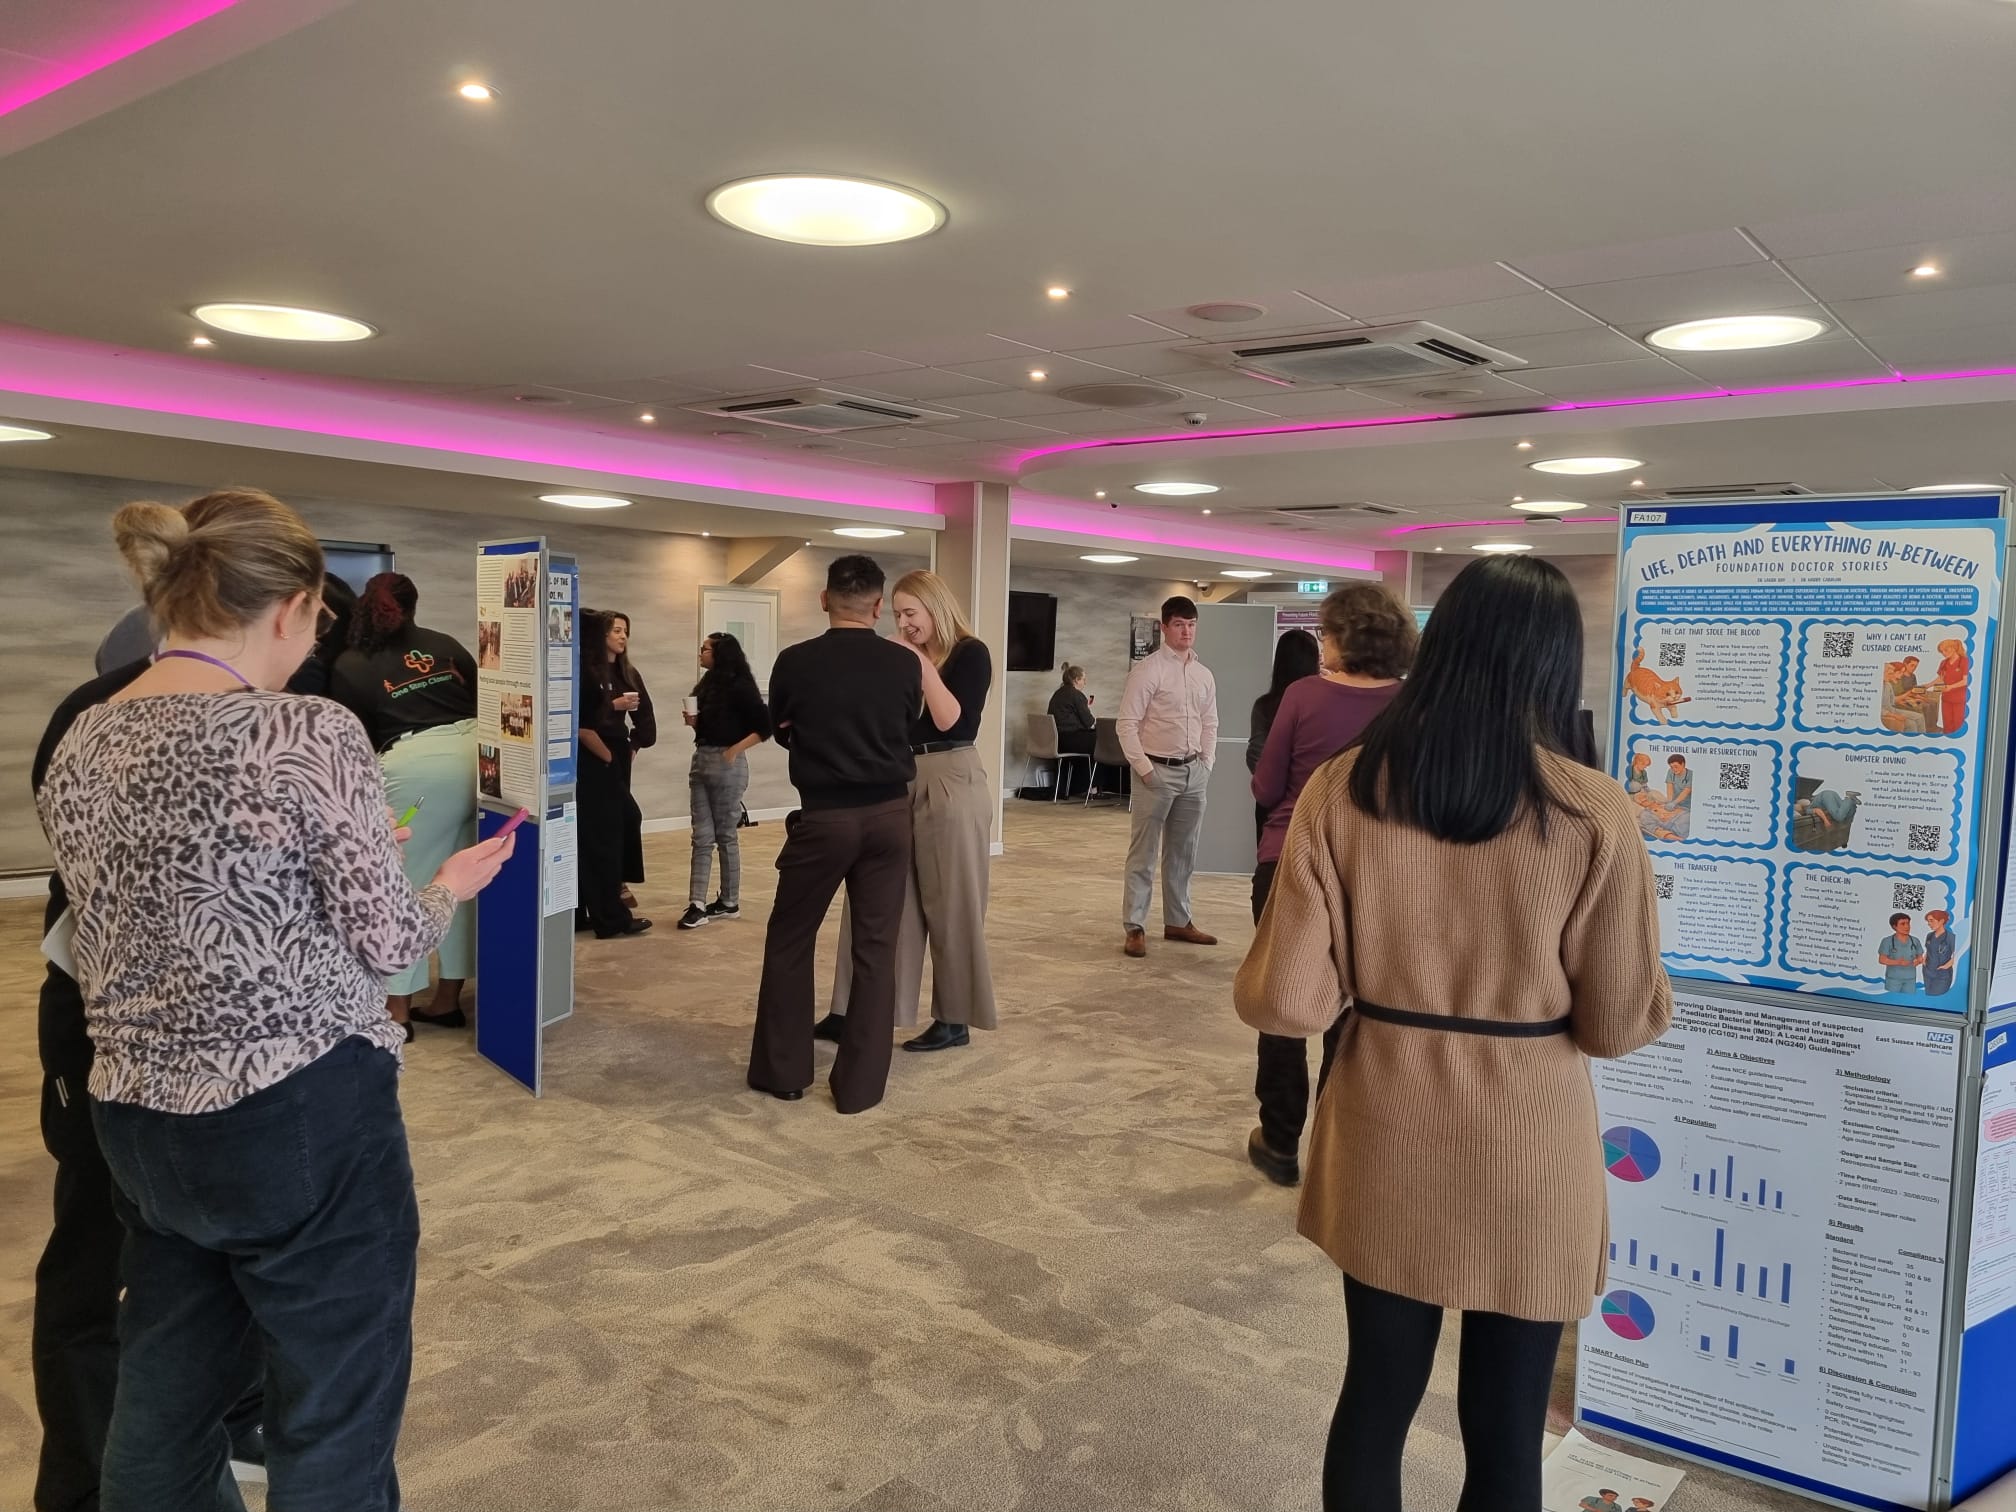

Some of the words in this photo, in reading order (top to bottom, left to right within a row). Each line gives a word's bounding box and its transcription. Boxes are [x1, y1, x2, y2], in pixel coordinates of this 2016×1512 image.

[1633, 514, 1661, 522] FA107
[1641, 559, 1674, 581] LIFE,
[1677, 544, 1726, 569] DEATH
[1733, 538, 1764, 557] AND
[1771, 535, 1872, 555] EVERYTHING
[1877, 540, 1979, 580] IN-BETWEEN
[1716, 562, 1784, 573] FOUNDATION
[1791, 562, 1834, 572] DOCTOR
[1842, 561, 1888, 571] STORIES
[1706, 628, 1723, 636] STOLE
[1862, 644, 1891, 652] CUSTARD
[392, 688, 408, 698] One
[409, 681, 428, 690] Step
[1663, 745, 1689, 753] TROUBLE
[1709, 748, 1758, 757] RESURRECTION
[1845, 754, 1880, 763] DUMPSTER
[1883, 756, 1906, 764] DIVING
[1688, 864, 1718, 872] TRANSFER
[1806, 874, 1817, 882] THE
[1820, 875, 1851, 885] CHECK-IN
[1673, 1000, 1704, 1011] proving
[1706, 1004, 1743, 1017] Diagnosis
[1745, 1010, 1759, 1018] and
[1760, 1012, 1810, 1026] Management
[1822, 1022, 1864, 1033] suspected
[1680, 1008, 1717, 1020] Paediatric
[1719, 1013, 1751, 1025] Bacterial
[1753, 1019, 1793, 1032] Meningitis
[1795, 1025, 1809, 1033] and
[1811, 1027, 1844, 1039] Invasive
[1671, 1016, 1720, 1028] eningococcal
[1722, 1022, 1751, 1033] Disease
[1753, 1027, 1775, 1037] (IMD):
[1785, 1032, 1806, 1042] Local
[1808, 1035, 1830, 1046] Audit
[1831, 1039, 1861, 1050] against
[1671, 1022, 1687, 1030] NICE
[1689, 1025, 1707, 1034] 2010
[1708, 1027, 1738, 1040] (CG102)
[1740, 1033, 1754, 1041] and
[1755, 1035, 1773, 1045] 2024
[1775, 1038, 1806, 1050] (NG240)
[1927, 1032, 1953, 1043] NHS
[1654, 1040, 1685, 1050] ckground
[1891, 1038, 1914, 1046] Sussex
[1916, 1041, 1953, 1050] Healthcare
[1714, 1049, 1731, 1058] Aims
[1740, 1053, 1775, 1065] Objectives
[1711, 1064, 1731, 1072] Assess
[1748, 1070, 1773, 1079] guideline
[1844, 1070, 1891, 1084] Methodology
[1710, 1084, 1729, 1092] Assess
[1711, 1074, 1734, 1083] Evaluate
[1764, 1083, 1783, 1092] testing
[1709, 1094, 1729, 1102] Assess
[1845, 1091, 1876, 1101] Suspected
[1877, 1096, 1902, 1105] bacterial
[1904, 1101, 1935, 1111] meningitis
[1709, 1104, 1731, 1113] Address
[1843, 1106, 1869, 1115] Admitted
[1857, 1101, 1882, 1109] between
[1889, 1106, 1911, 1115] months
[1681, 1116, 1717, 1129] Population
[1837, 1220, 1864, 1232] Results
[1825, 1233, 1854, 1245] Standard
[1898, 1248, 1937, 1263] Compliance
[1831, 1281, 1853, 1291] Lumbar
[1855, 1286, 1881, 1297] Puncture
[1887, 1302, 1901, 1310] PCR
[1591, 1346, 1613, 1358] SMART
[1615, 1354, 1634, 1364] Action
[1635, 1359, 1649, 1368] Plan
[1828, 1369, 1867, 1384] Discussion
[1876, 1380, 1917, 1398] Conclusion
